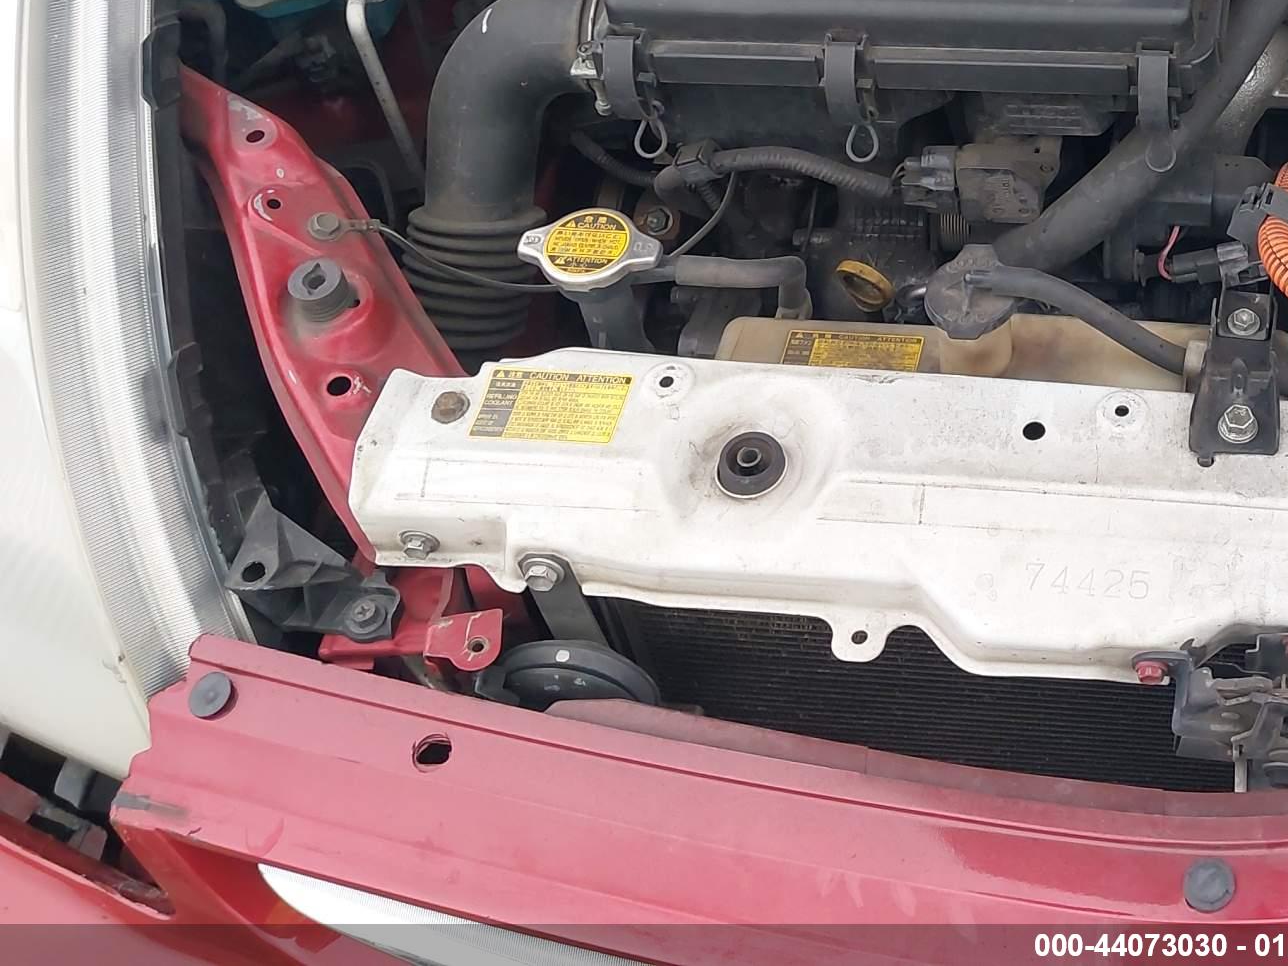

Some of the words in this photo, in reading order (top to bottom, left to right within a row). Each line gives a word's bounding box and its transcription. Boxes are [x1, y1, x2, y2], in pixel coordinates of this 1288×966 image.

[577, 222, 617, 230] CAUTION
[566, 256, 608, 264] ATTENTION
[529, 372, 570, 381] CAUTION
[576, 375, 627, 384] ATTENTION
[1025, 562, 1150, 600] 74425
